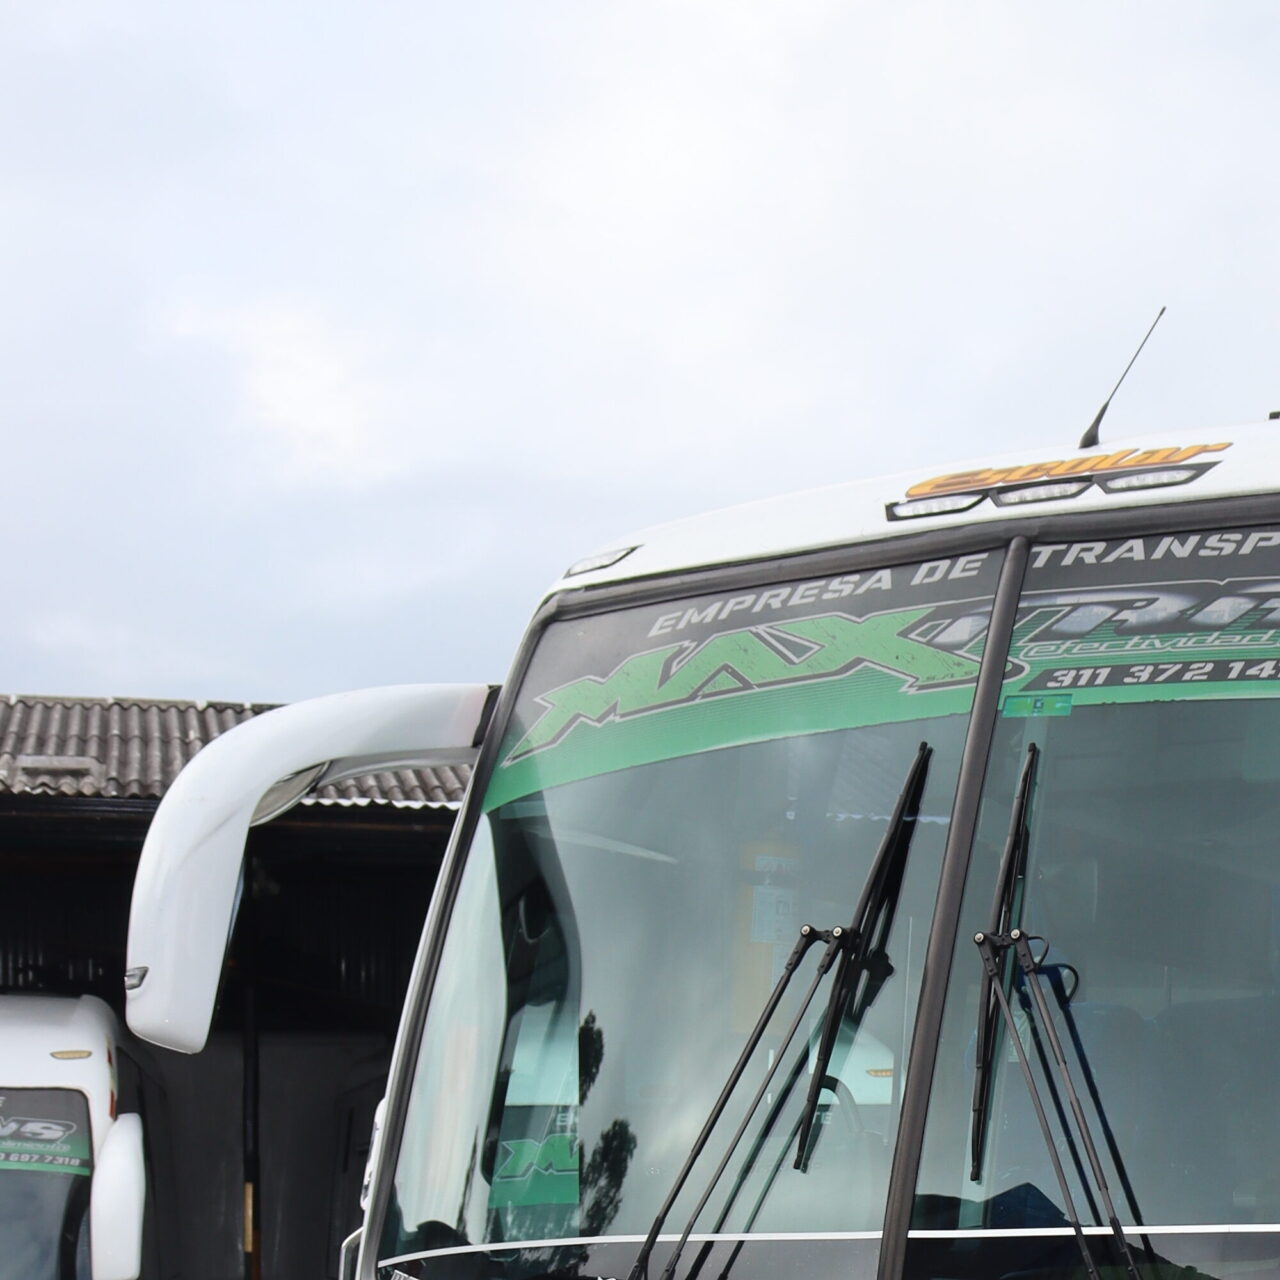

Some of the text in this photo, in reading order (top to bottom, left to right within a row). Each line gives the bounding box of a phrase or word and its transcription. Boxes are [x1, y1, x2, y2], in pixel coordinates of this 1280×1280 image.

[905, 442, 1234, 498] Escolar
[648, 568, 893, 638] EMPRESA
[911, 553, 989, 585] DE
[1027, 629, 1277, 658] efectividad
[1046, 667, 1110, 689] 311
[1123, 663, 1214, 685] 372
